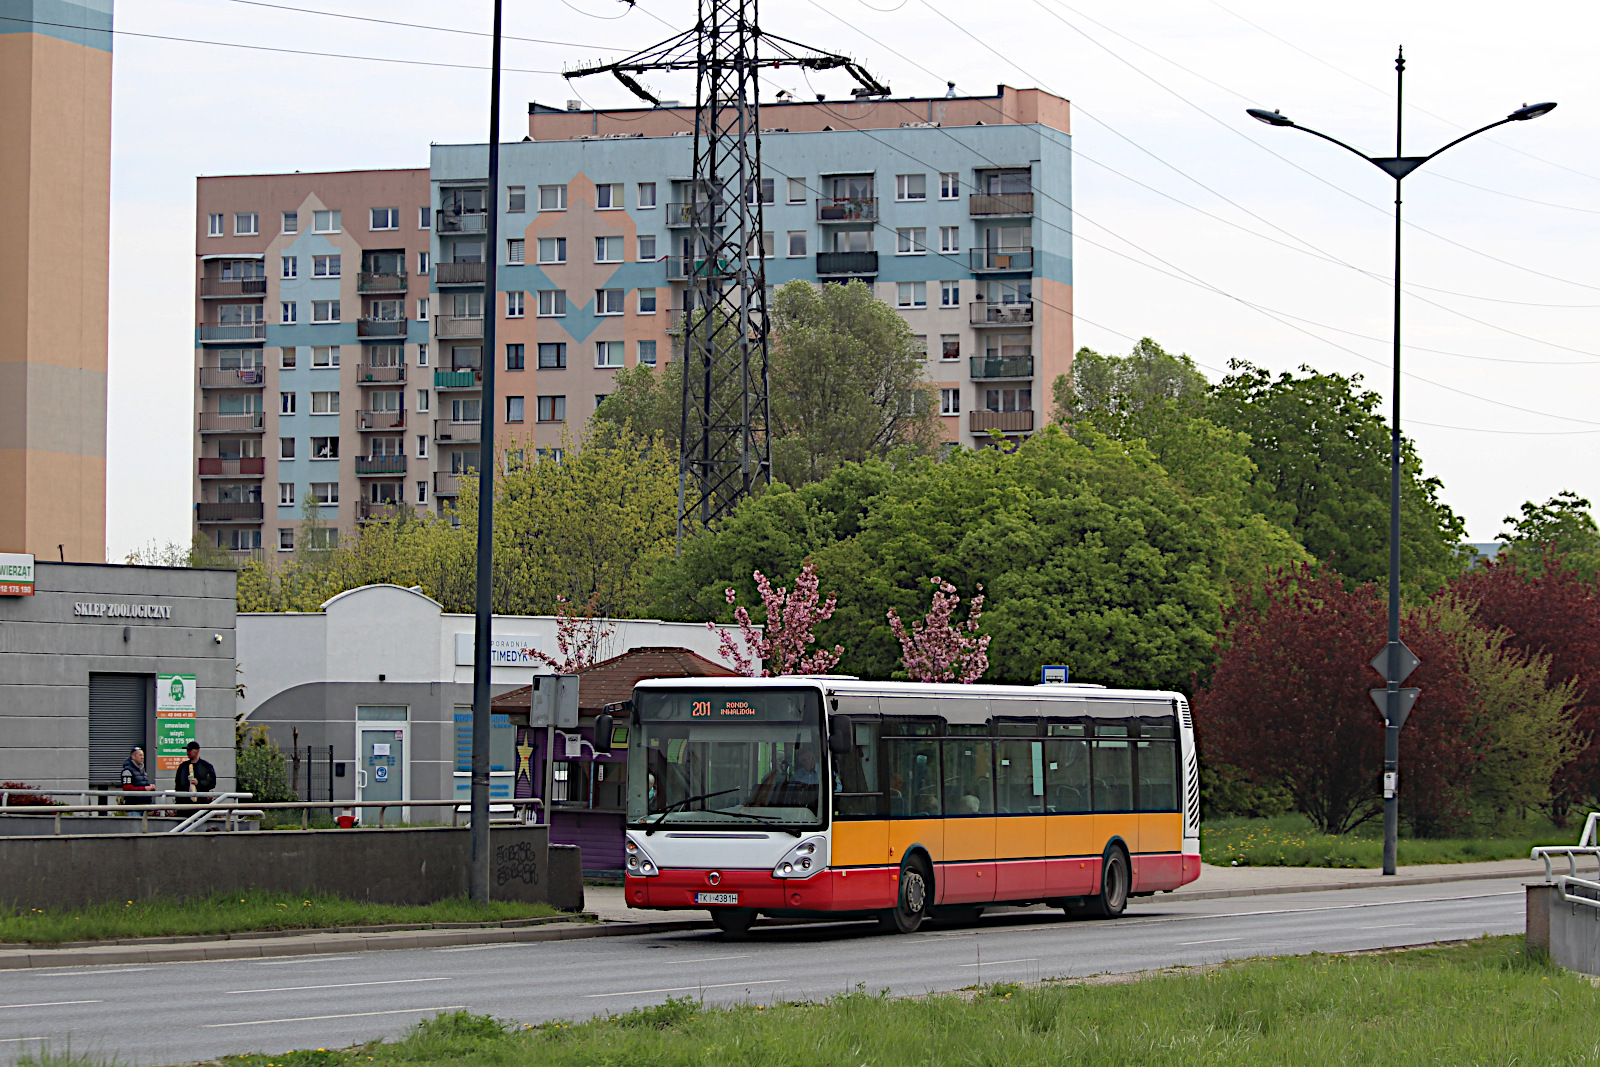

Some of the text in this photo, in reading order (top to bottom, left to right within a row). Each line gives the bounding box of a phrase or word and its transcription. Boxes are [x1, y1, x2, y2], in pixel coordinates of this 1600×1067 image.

[9, 585, 19, 593] 175
[74, 602, 173, 619] SKLEP ZOOLOGICZNY
[491, 650, 528, 661] TIMEDYK
[692, 701, 711, 716] 201
[714, 894, 737, 903] 4381H
